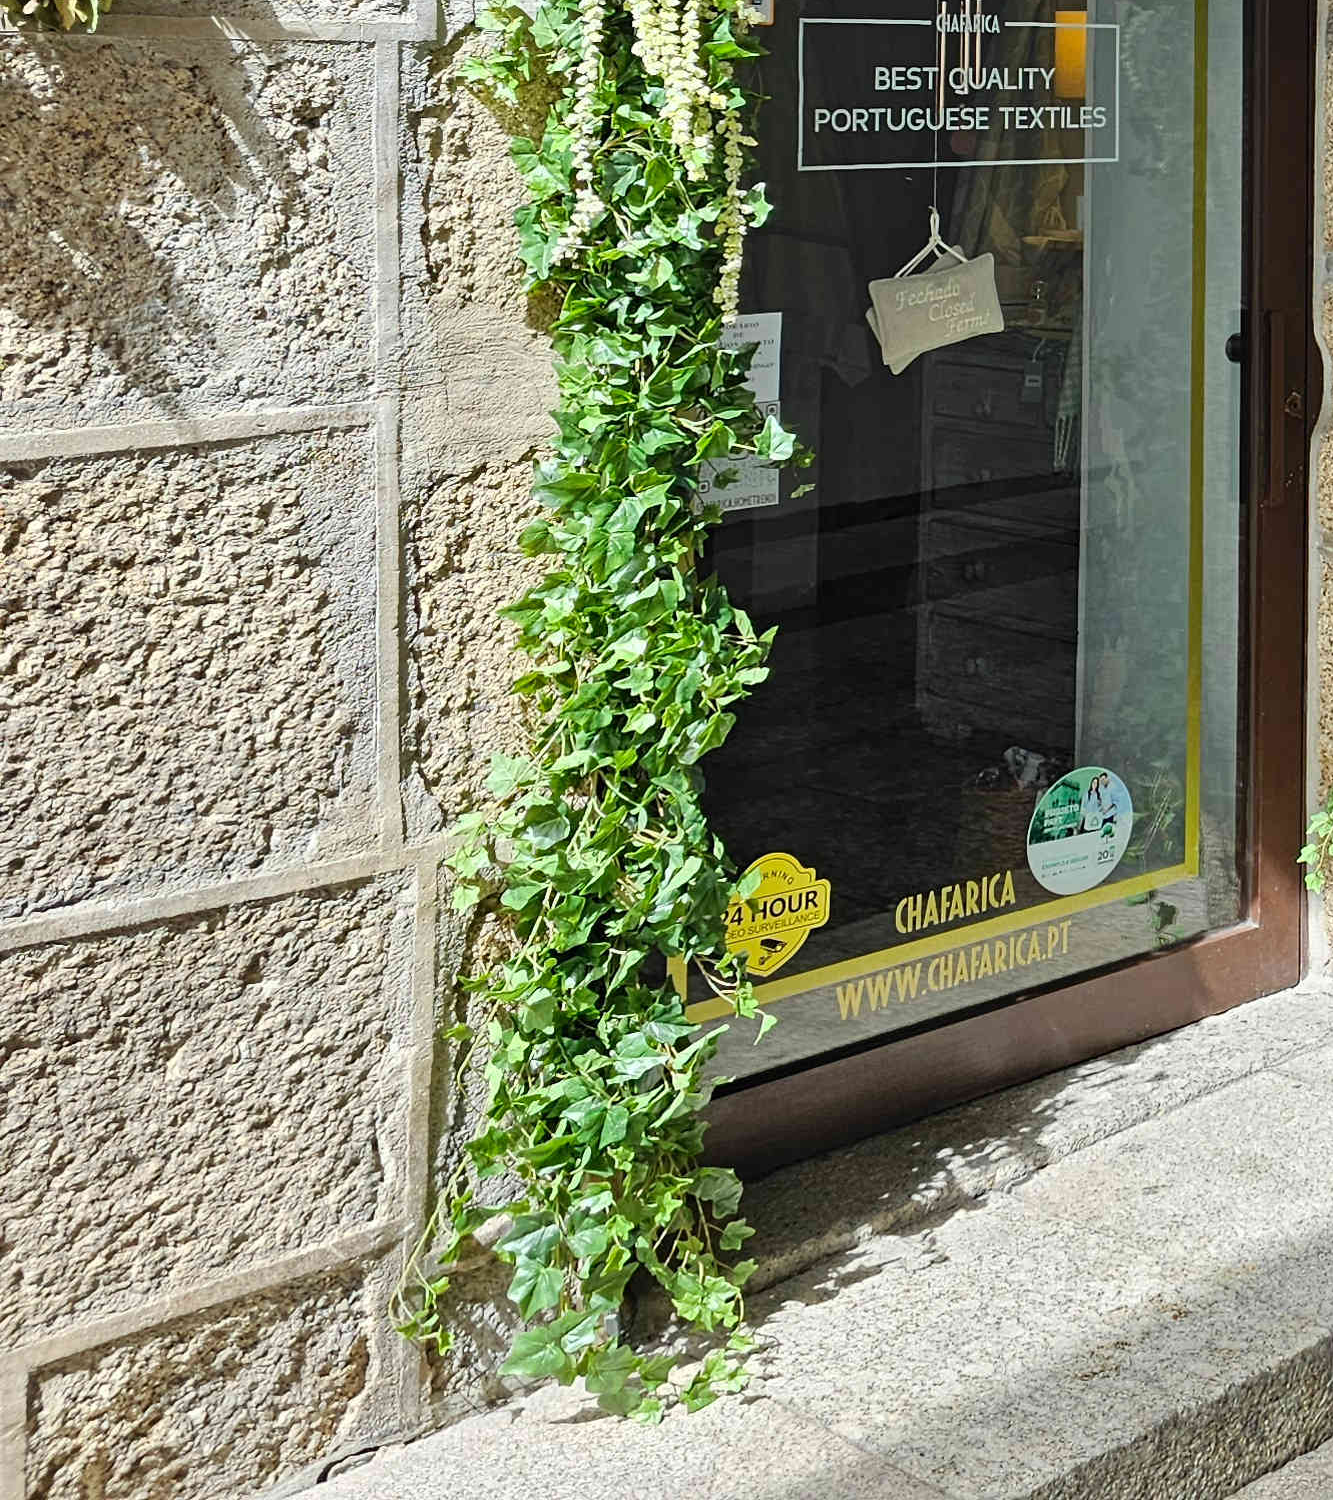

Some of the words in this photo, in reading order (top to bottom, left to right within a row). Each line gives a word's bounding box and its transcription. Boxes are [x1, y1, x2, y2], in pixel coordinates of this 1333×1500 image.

[936, 13, 1000, 34] CHAFARICA
[874, 66, 939, 91] BEST
[949, 67, 1056, 95] QUALITY
[814, 107, 989, 132] PORTUGUESE
[999, 106, 1107, 130] TEXTILES
[752, 890, 819, 923] HOUR
[896, 870, 1016, 934] CHAFARICA
[748, 910, 820, 936] SURVEILLANCE
[836, 920, 1072, 1021] WWW.CHAFARICA.PT
